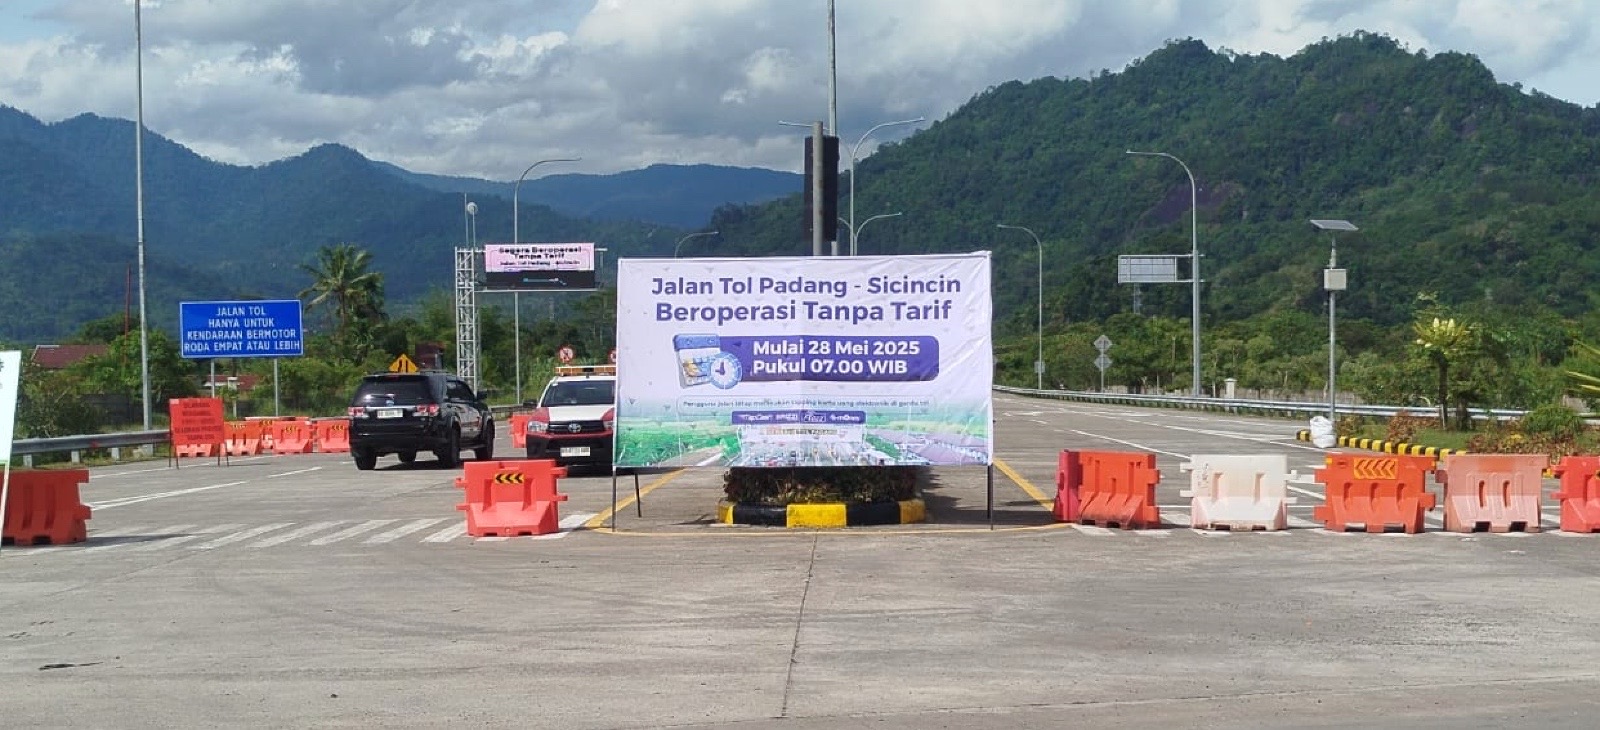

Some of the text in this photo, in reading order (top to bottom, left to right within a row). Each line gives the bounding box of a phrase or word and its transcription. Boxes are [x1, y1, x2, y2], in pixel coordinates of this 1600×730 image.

[652, 277, 713, 295] Jalan
[719, 276, 752, 294] Tol
[760, 276, 847, 298] Padang
[867, 274, 961, 294] Sicincin
[216, 306, 266, 316] JALAN TOL
[656, 299, 952, 326] Beroperasi Tanpa Tarif
[208, 317, 275, 328] HANYA UNTUK
[187, 329, 296, 340] KENDARAAN BERMOTOR
[184, 340, 300, 352] RODA EMPAT ATAU LEBIH
[753, 339, 921, 355] Mulai 28 Mei 2025
[753, 358, 908, 374] Pukul 07.00 WIB
